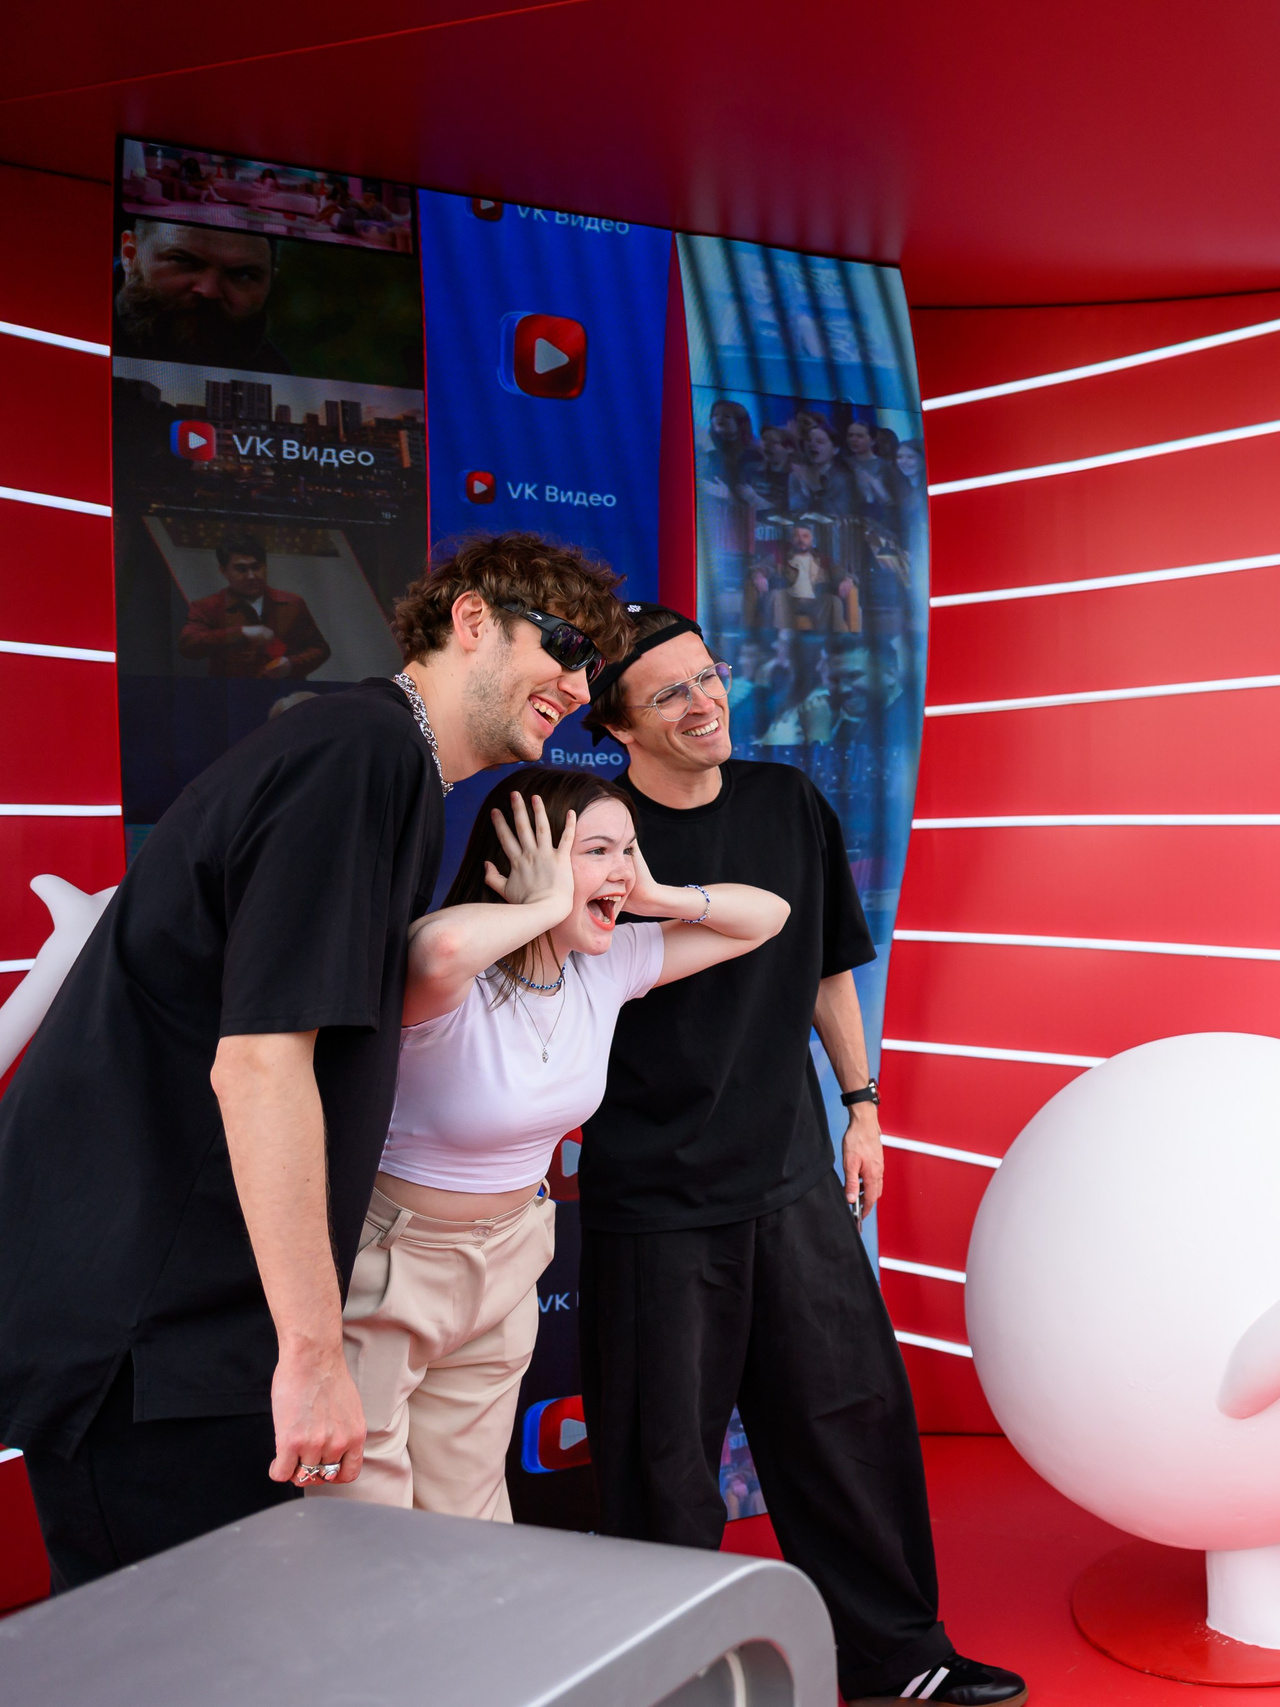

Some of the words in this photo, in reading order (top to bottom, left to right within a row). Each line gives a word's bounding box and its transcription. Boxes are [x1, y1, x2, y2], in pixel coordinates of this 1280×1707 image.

[554, 210, 630, 236] Видео
[232, 434, 275, 458] VK
[282, 439, 375, 468] Видео
[506, 481, 539, 501] VK
[545, 485, 617, 508] Видео
[550, 748, 624, 767] Видео
[537, 1292, 571, 1313] VK
